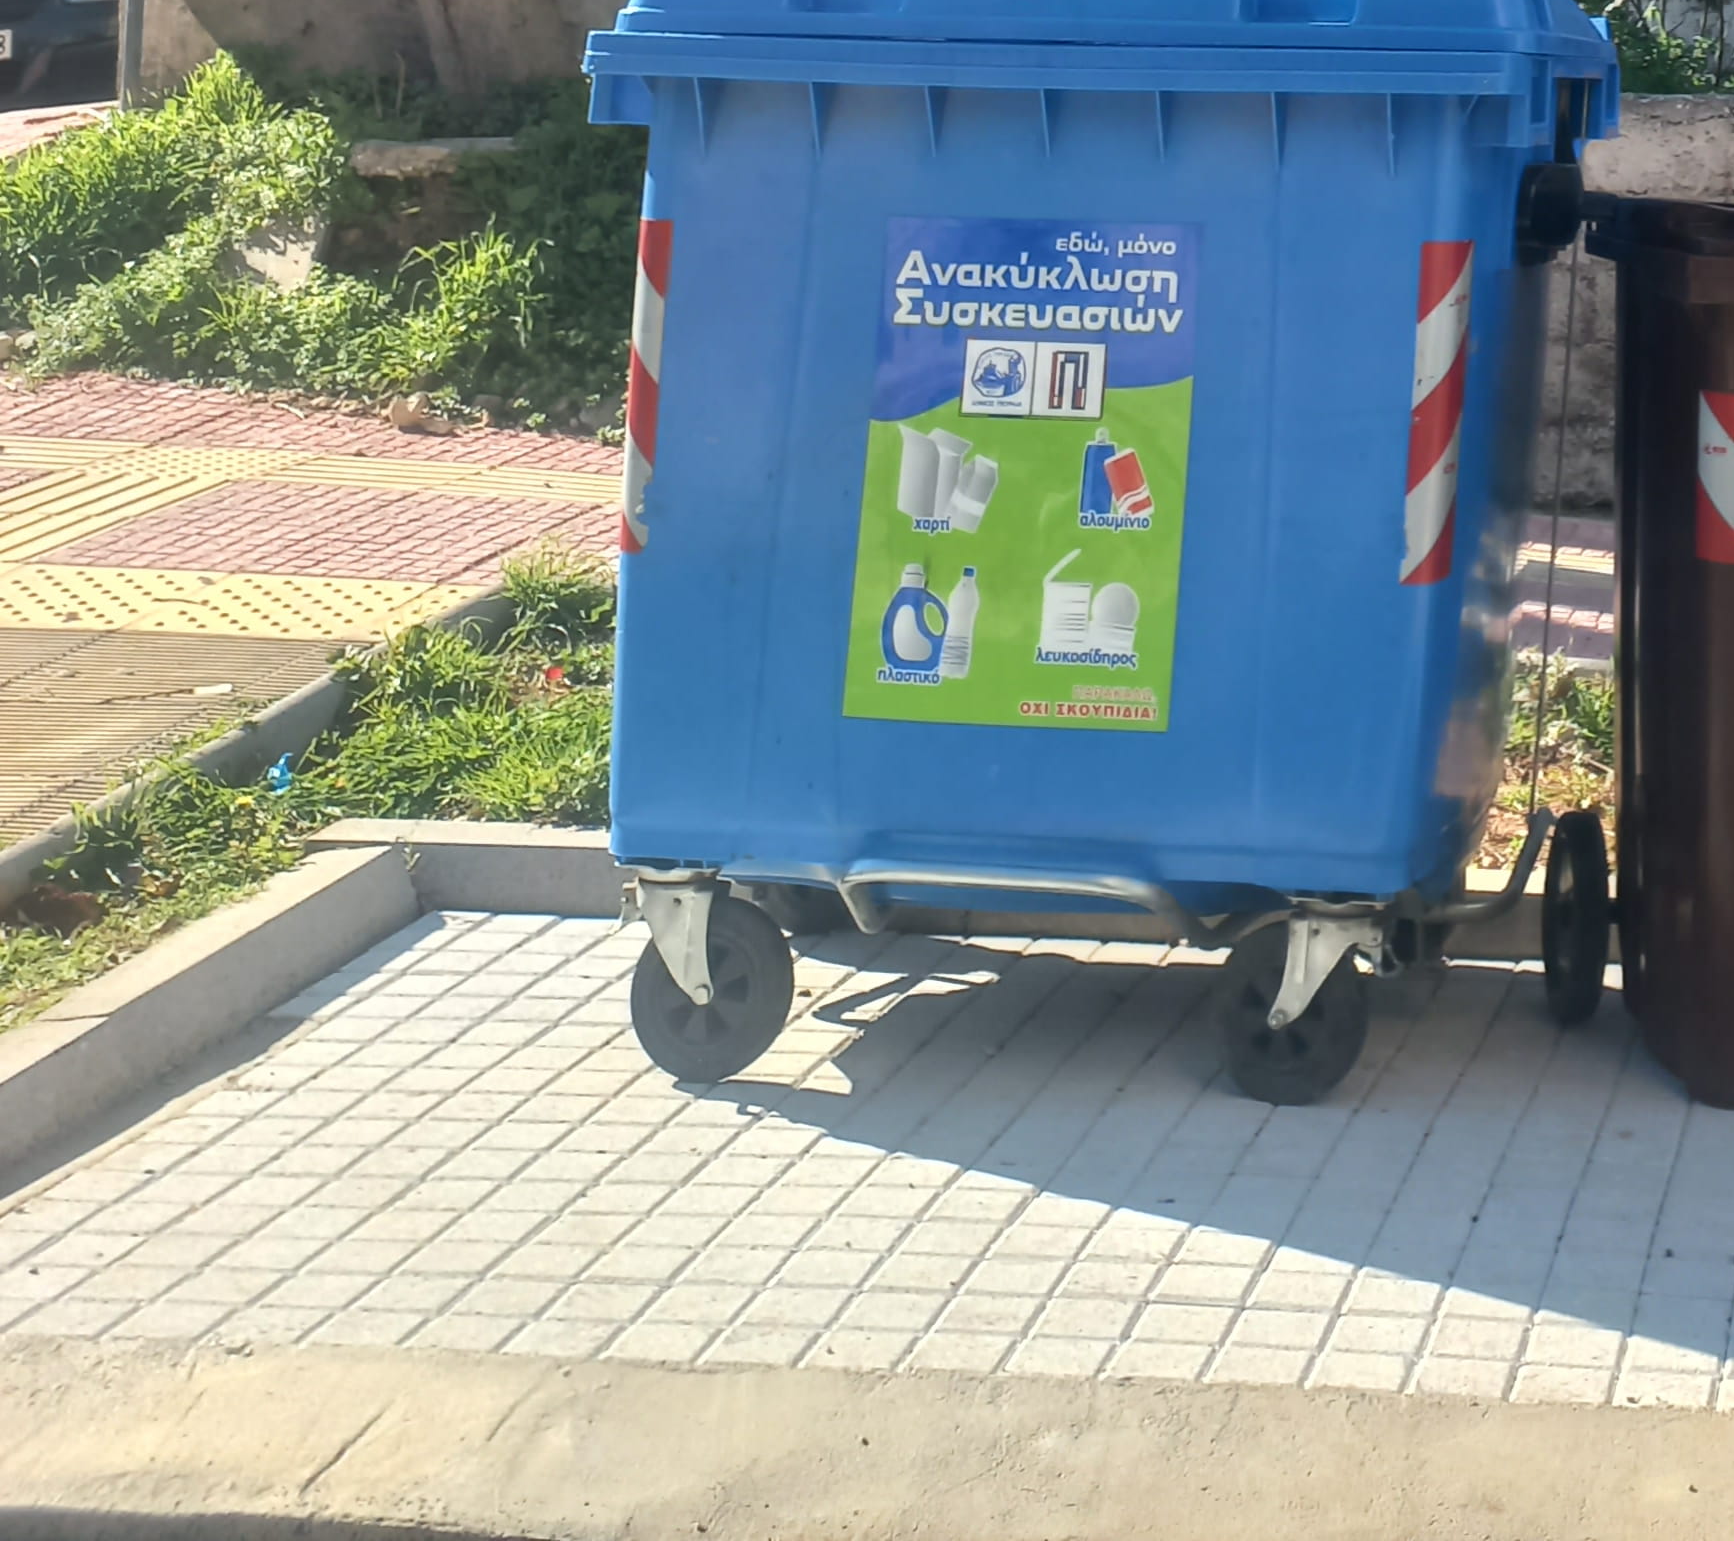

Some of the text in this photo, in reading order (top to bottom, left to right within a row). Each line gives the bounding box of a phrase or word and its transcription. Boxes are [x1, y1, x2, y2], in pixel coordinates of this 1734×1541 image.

[1055, 231, 1177, 258] εδώ, μόνο
[895, 249, 1179, 304] Ανακύκλωση
[893, 287, 1184, 333] Συσκευασιών
[913, 516, 950, 534] χαρτί
[1080, 512, 1150, 532] αλουμίνιο
[1035, 647, 1137, 668] λευκοσίδηρος
[1019, 702, 1049, 715] ΟΧΙ
